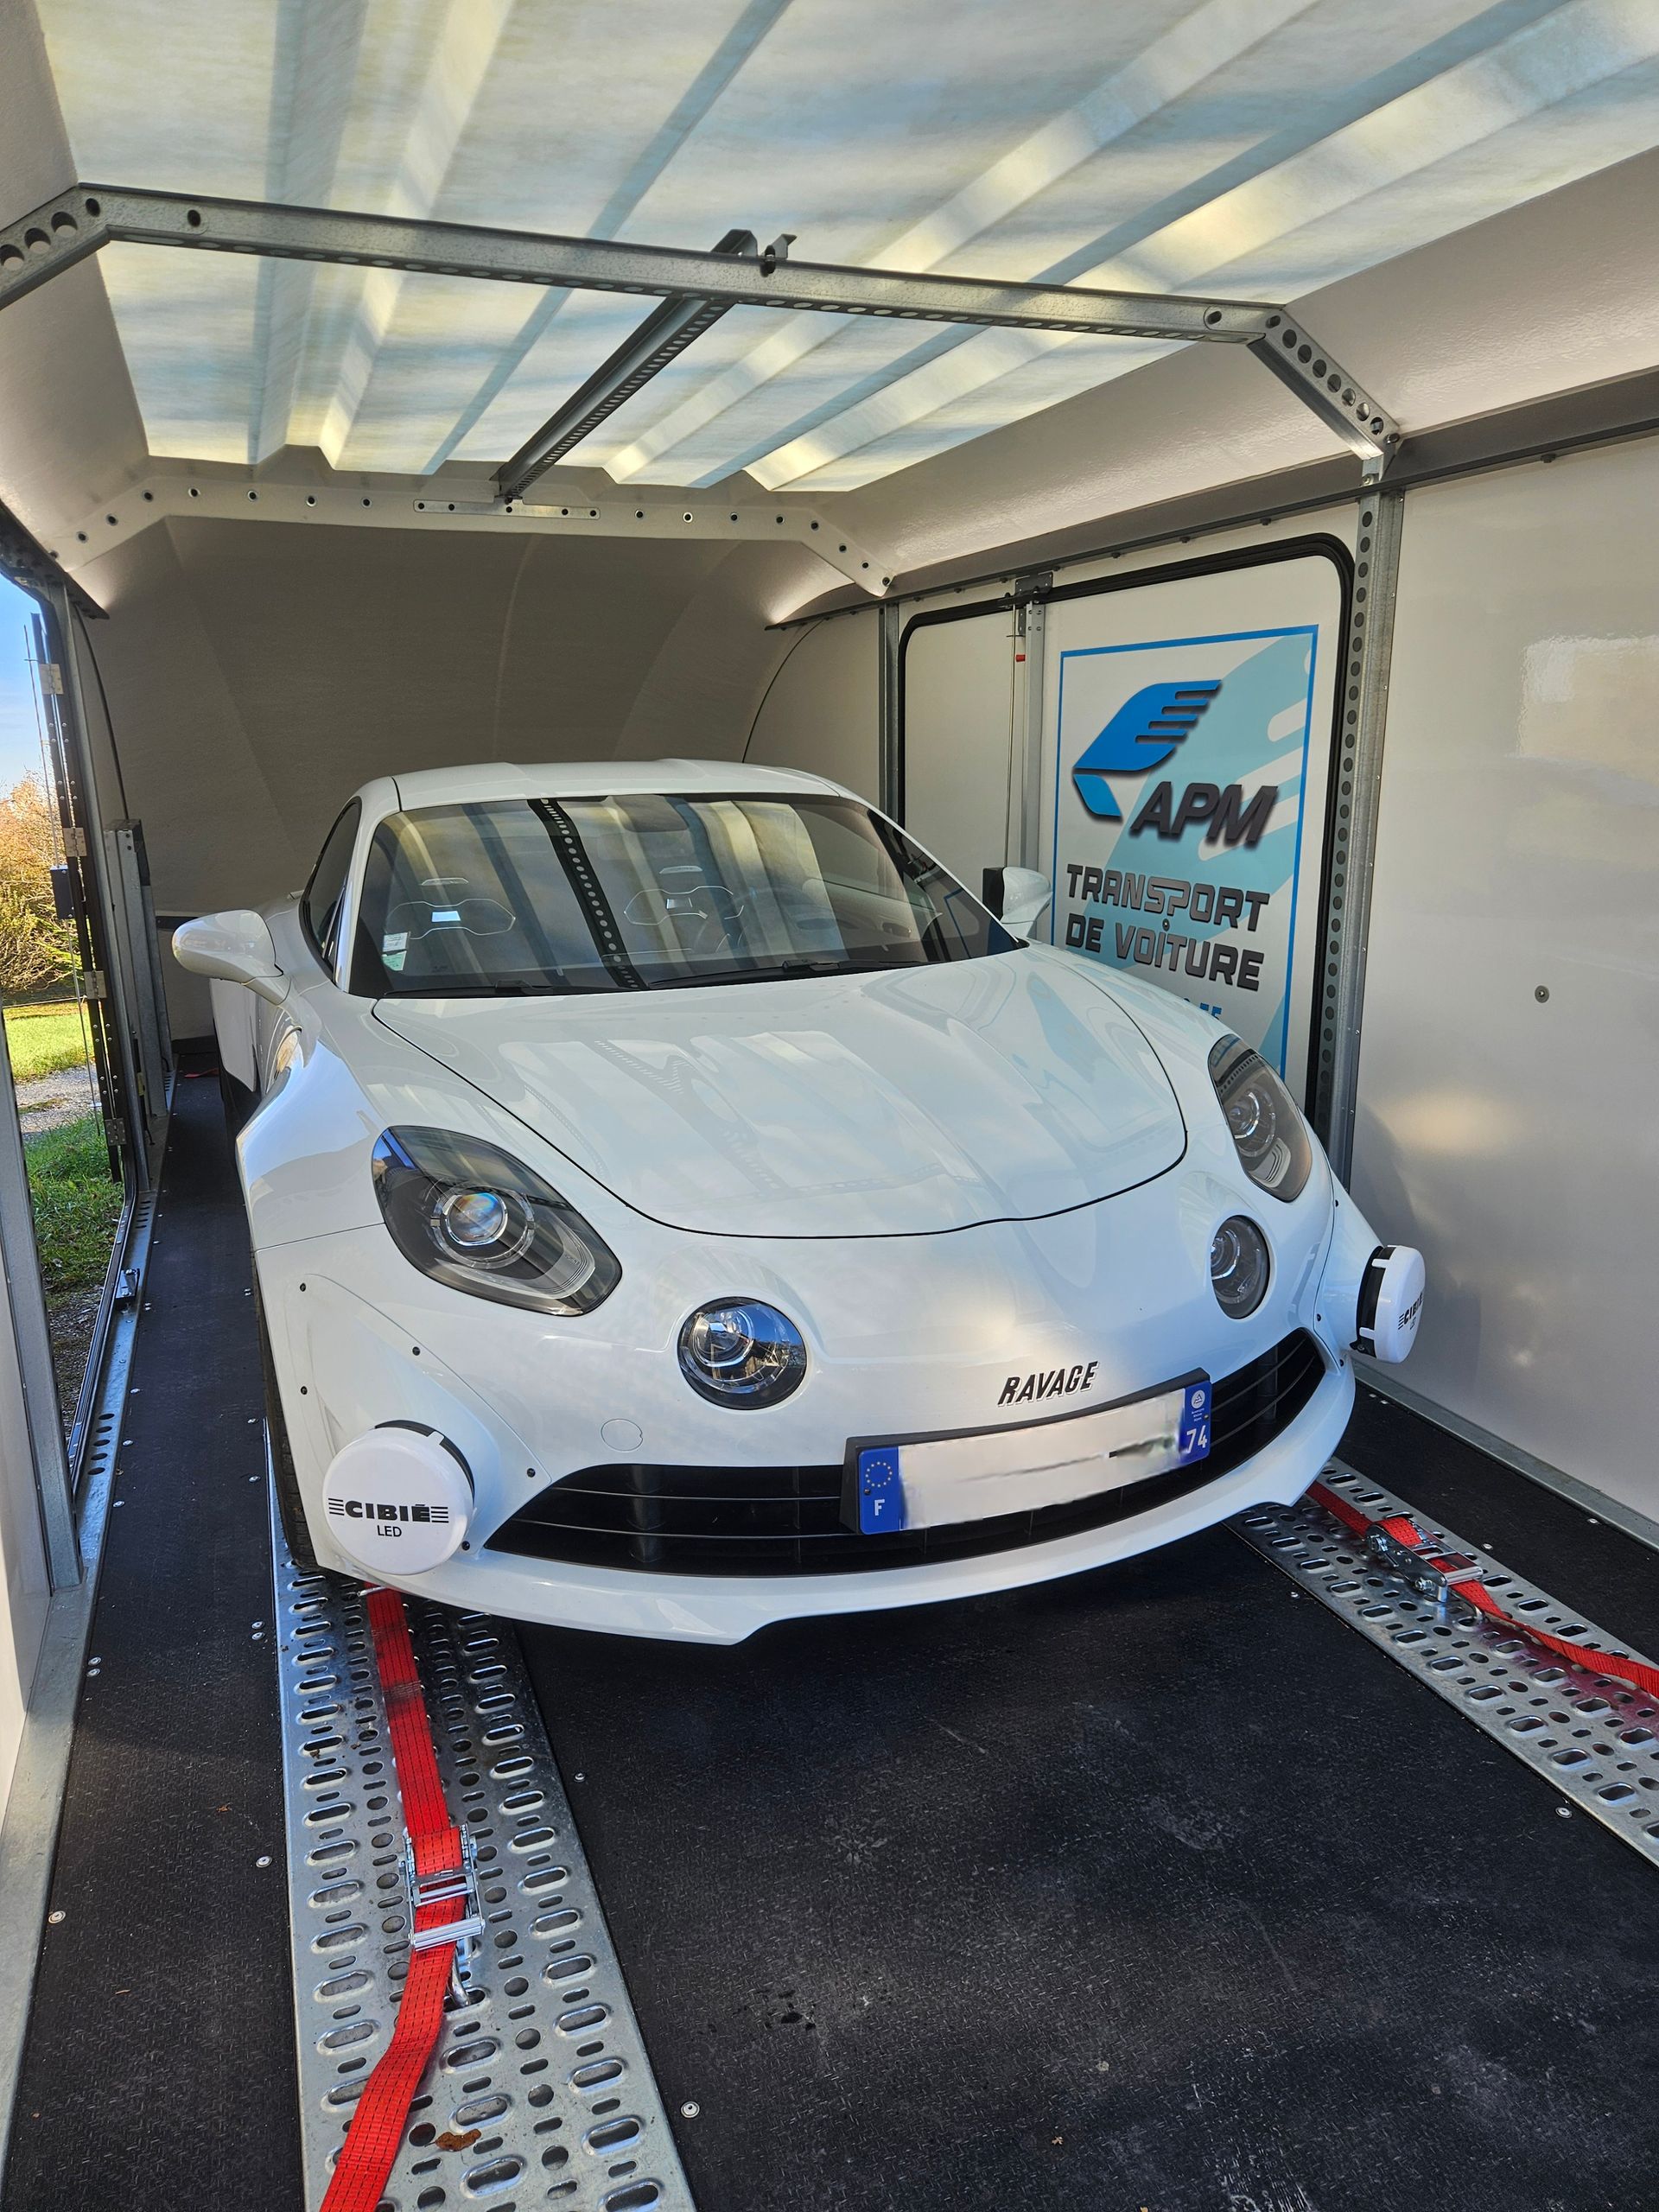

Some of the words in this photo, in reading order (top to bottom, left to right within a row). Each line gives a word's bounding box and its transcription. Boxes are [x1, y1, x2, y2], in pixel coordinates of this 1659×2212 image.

[1130, 780, 1279, 844] APM
[1066, 863, 1270, 931] TRANSPORT
[1065, 912, 1104, 952] DE
[1116, 922, 1265, 991] VOITURE
[997, 1361, 1098, 1406] RAVAGE
[1186, 1424, 1208, 1453] 74
[874, 1498, 886, 1516] F
[377, 1525, 402, 1537] LED
